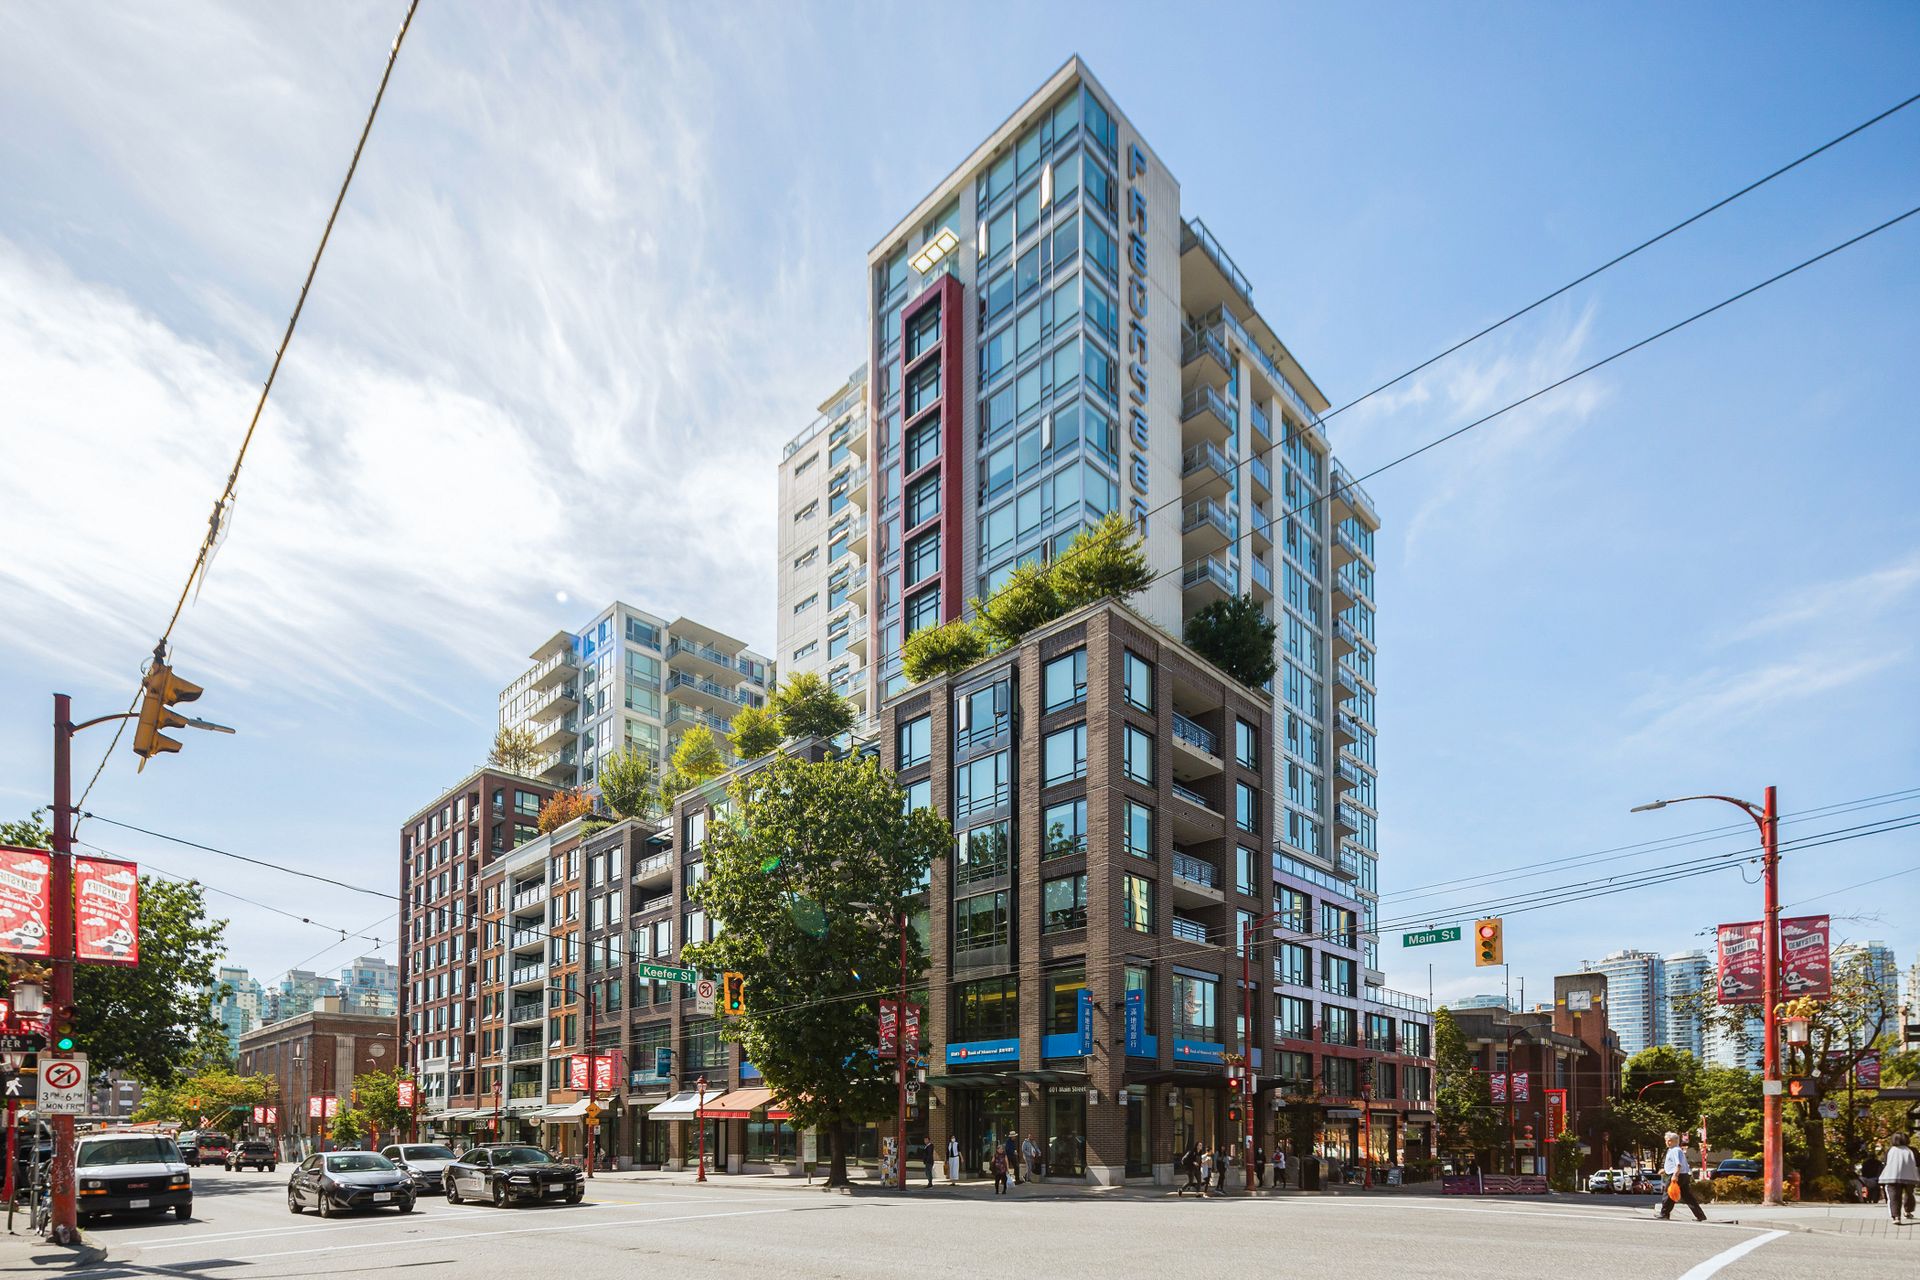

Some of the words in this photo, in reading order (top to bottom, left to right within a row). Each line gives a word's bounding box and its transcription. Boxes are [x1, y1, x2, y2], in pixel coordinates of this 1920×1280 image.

[1408, 933, 1436, 945] Main
[1441, 930, 1455, 940] St
[1788, 935, 1821, 950] DEMYSTIFY
[643, 966, 677, 979] Keefer
[680, 971, 692, 981] St
